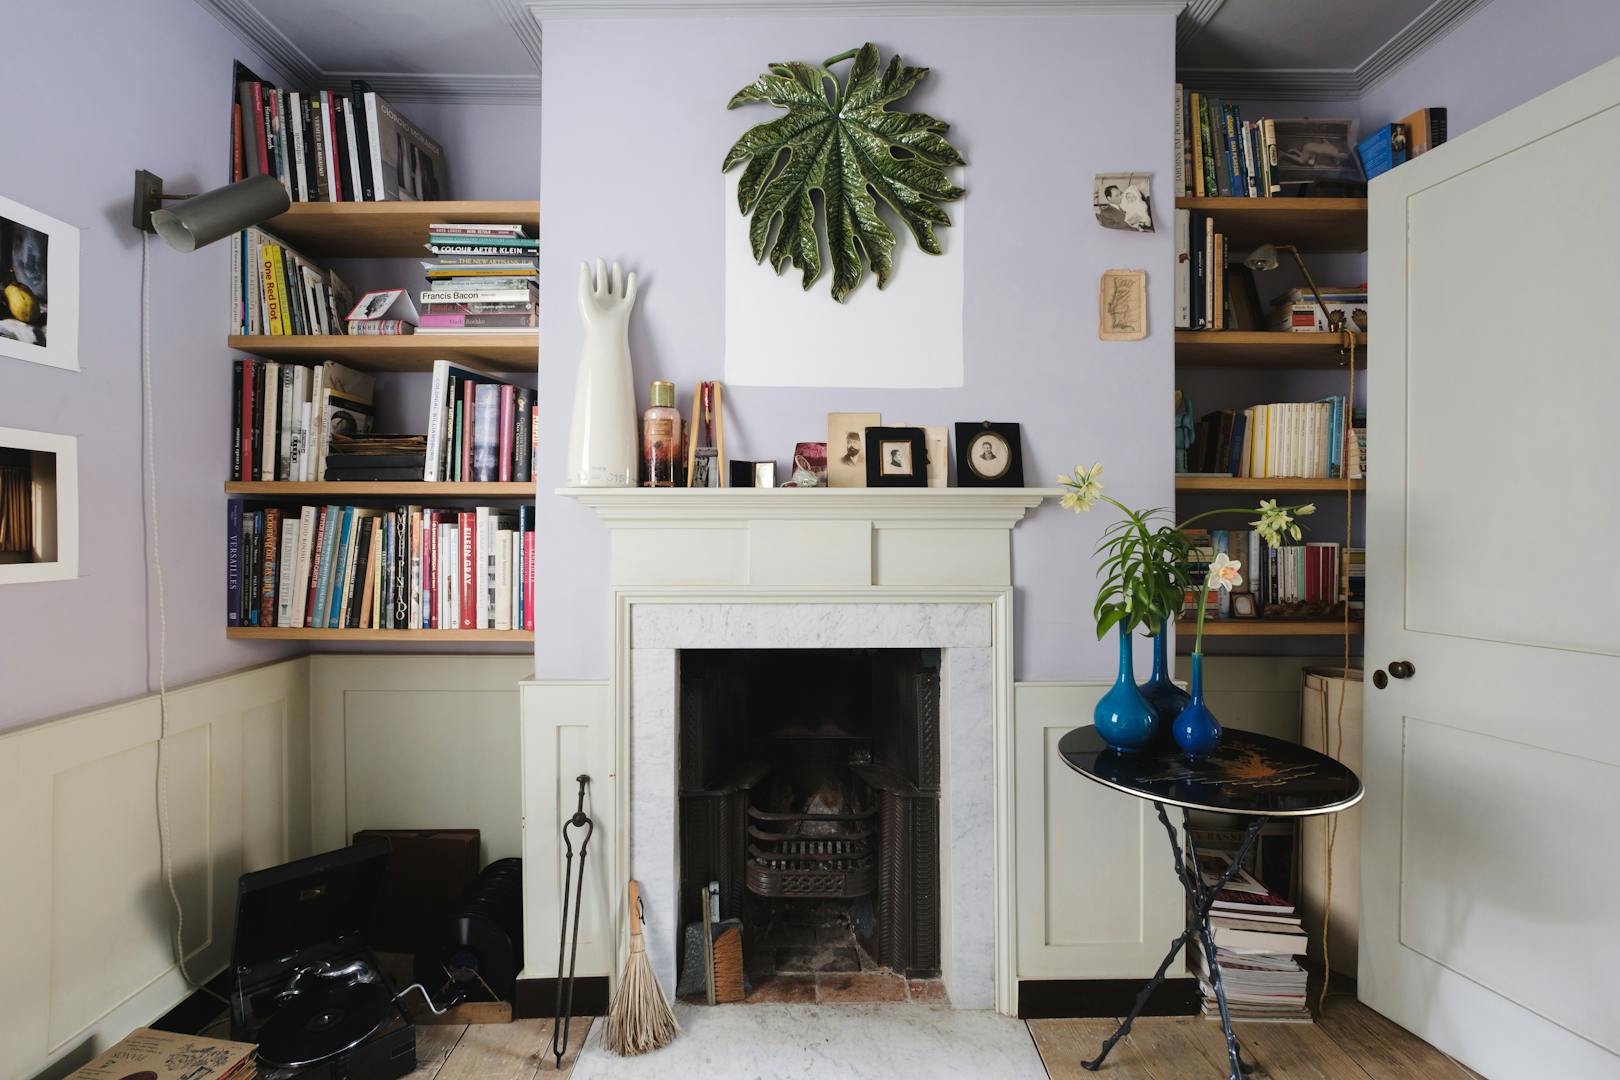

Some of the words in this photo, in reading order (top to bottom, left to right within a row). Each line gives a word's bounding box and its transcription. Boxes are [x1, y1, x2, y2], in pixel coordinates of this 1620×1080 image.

[440, 246, 472, 254] COLOUR
[472, 246, 498, 254] AFTER
[264, 261, 273, 280] One
[266, 282, 276, 301] Red
[422, 292, 452, 300] Francis
[453, 292, 479, 300] Bacon
[269, 303, 278, 320] Dot
[464, 527, 472, 557] EILEEN
[229, 535, 238, 590] VERSAILLES
[464, 559, 472, 585] GRAY
